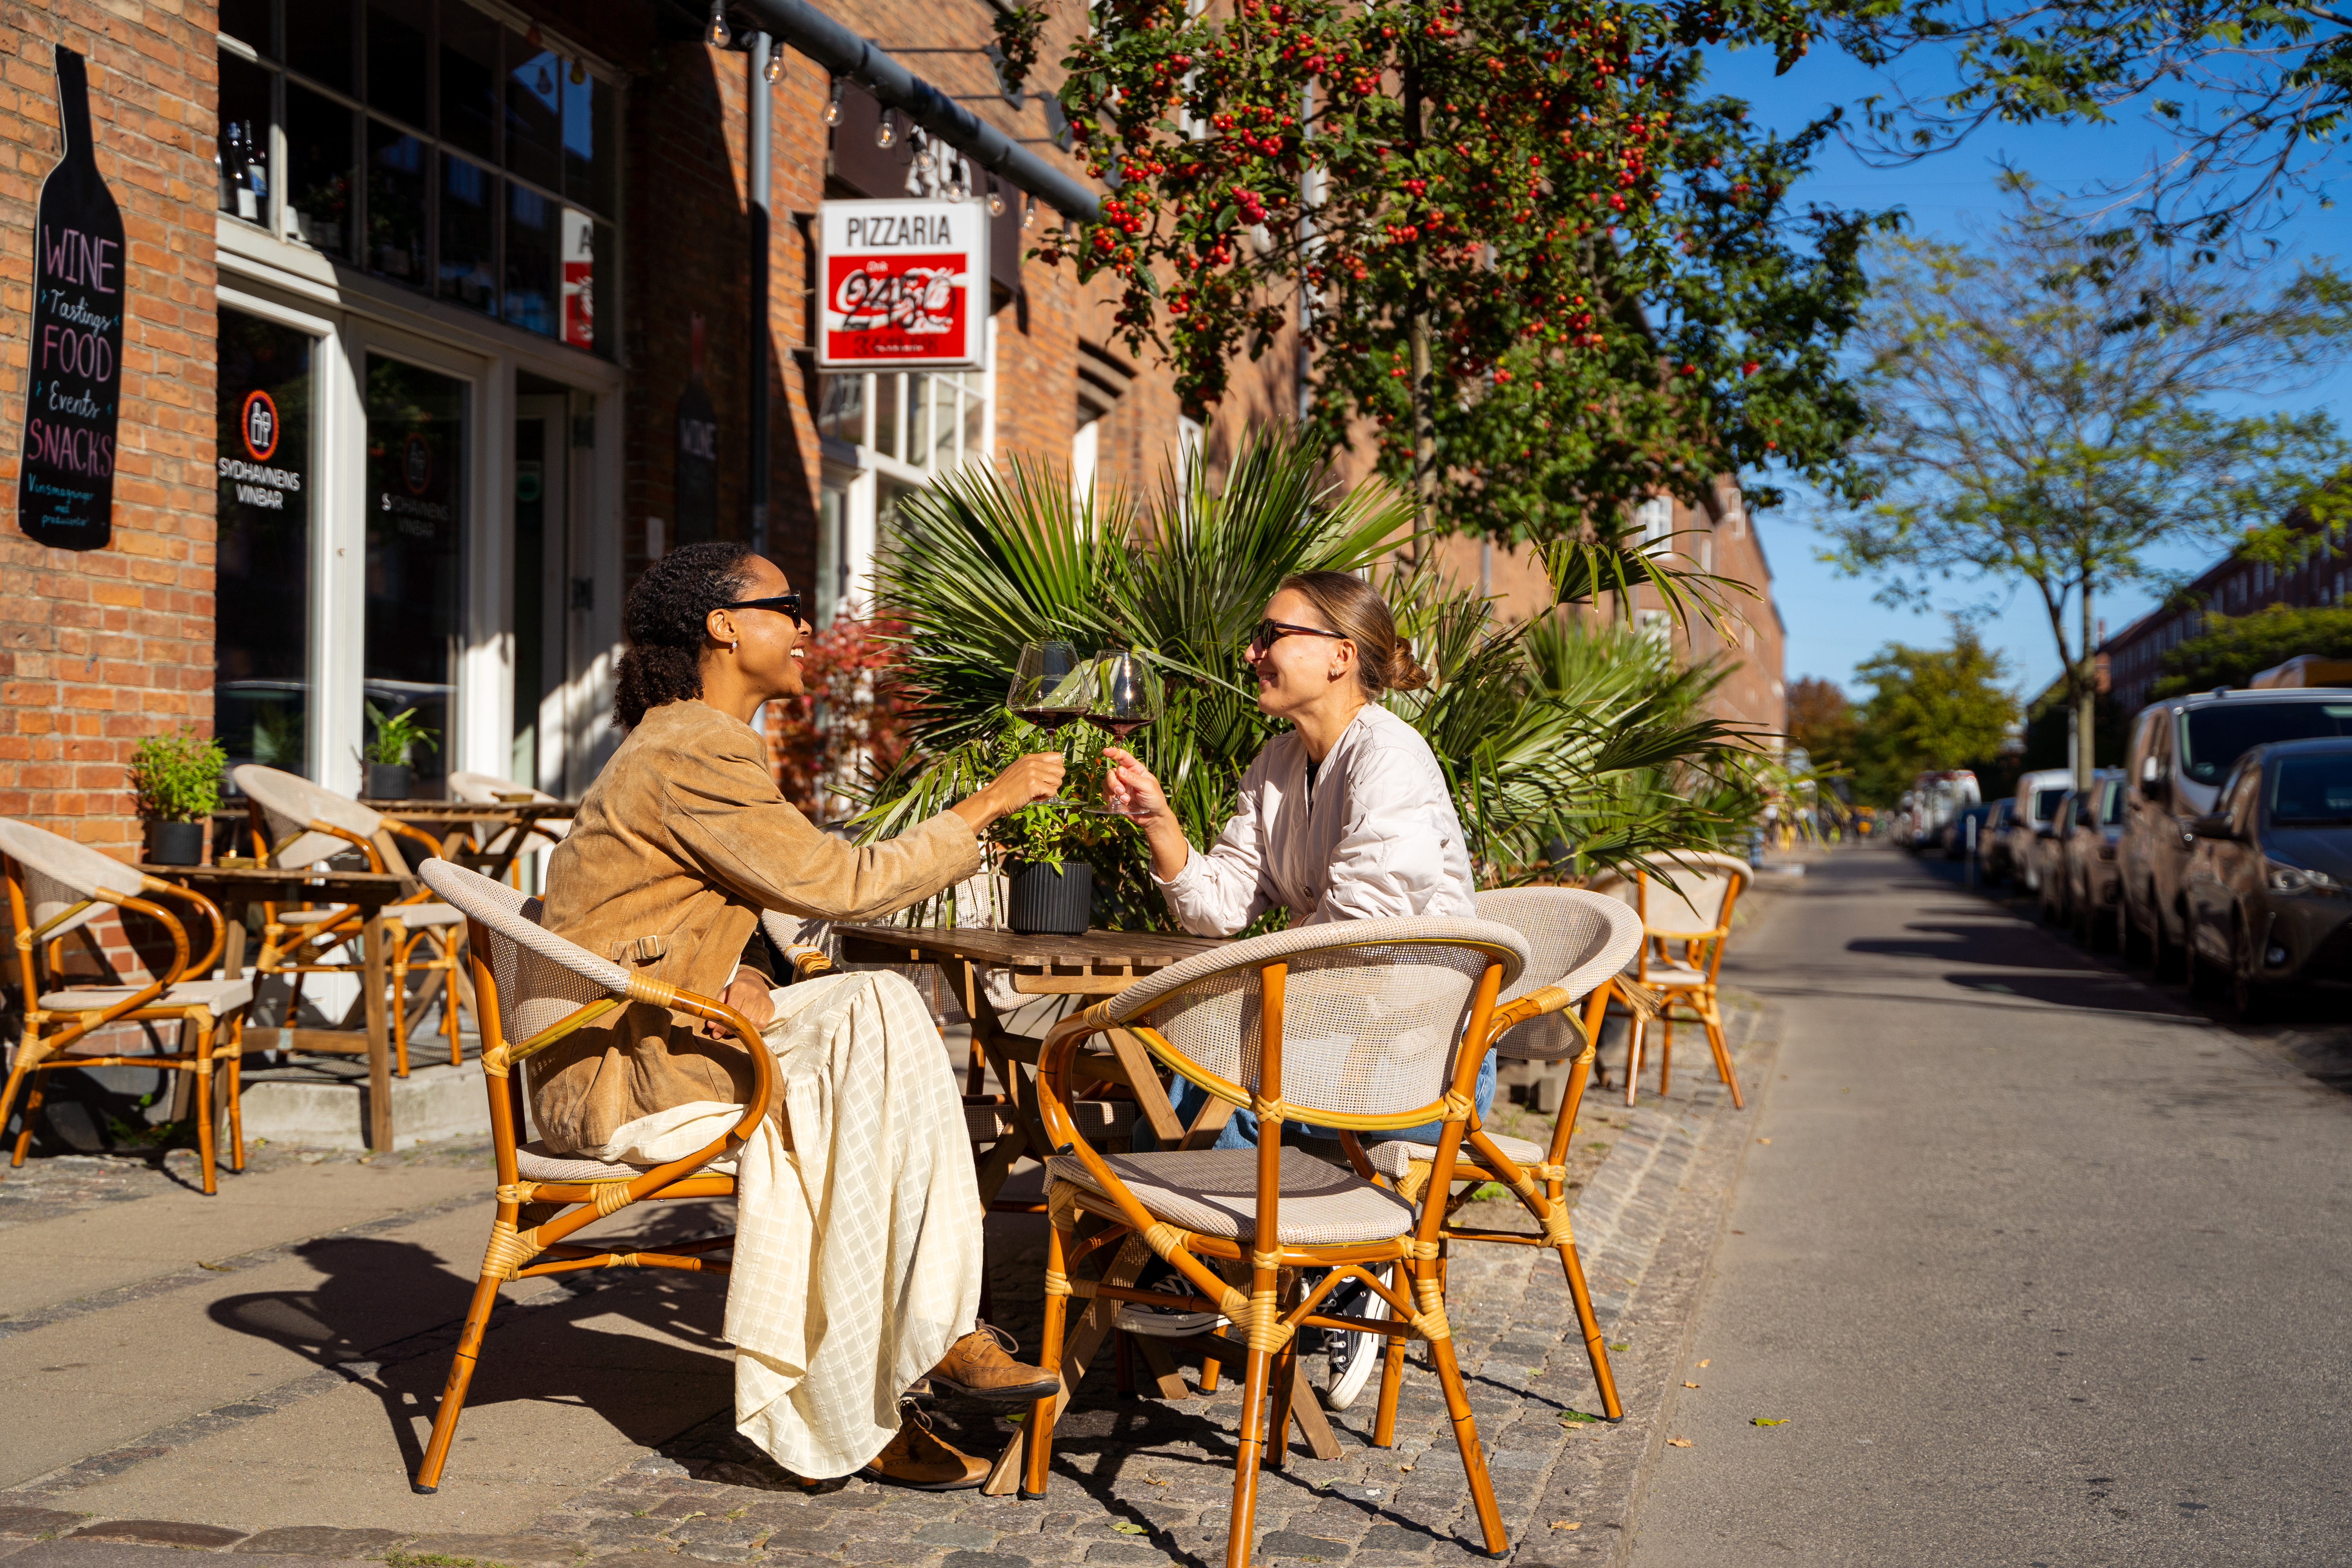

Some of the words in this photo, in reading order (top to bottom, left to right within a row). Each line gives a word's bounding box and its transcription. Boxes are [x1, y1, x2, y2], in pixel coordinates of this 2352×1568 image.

[847, 215, 953, 247] PIZZARIA
[44, 224, 119, 294] WINE
[50, 289, 112, 338] Tastings
[42, 324, 113, 383] FOOD
[48, 380, 101, 419] Events
[27, 418, 113, 478] SNACKS
[679, 418, 717, 461] WINE
[218, 457, 301, 492] SYDHAVNENS
[236, 483, 283, 510] VINBAR
